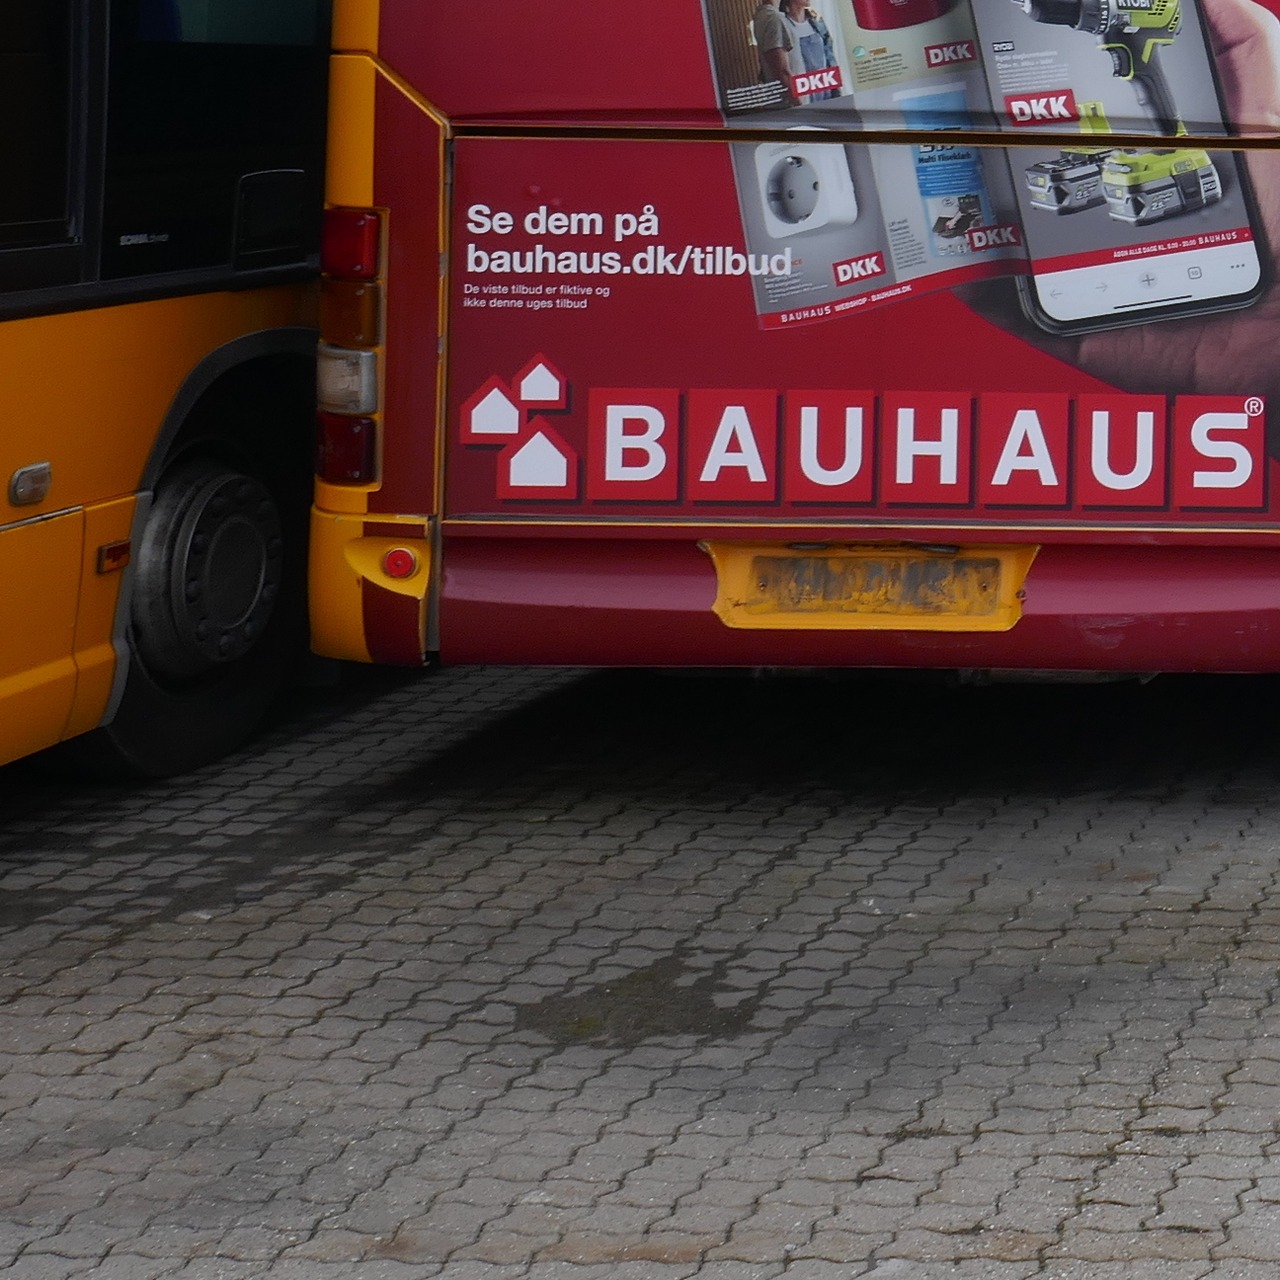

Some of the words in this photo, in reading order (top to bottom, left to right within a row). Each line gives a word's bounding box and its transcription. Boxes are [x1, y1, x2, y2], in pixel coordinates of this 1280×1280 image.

[928, 43, 972, 64] DKK
[795, 70, 839, 94] DKK
[1010, 95, 1072, 122] DKK
[467, 204, 514, 234] Se
[524, 206, 603, 235] dem
[614, 205, 659, 241] på
[972, 226, 1017, 248] DKK
[1198, 231, 1238, 245] BAUHAUS
[467, 244, 792, 276] bauhaus.dk/tilbud
[836, 255, 882, 282] DKK
[464, 284, 480, 294] De
[482, 284, 509, 294] viste
[511, 284, 543, 294] tilbud
[545, 286, 556, 294] er
[559, 284, 593, 295] fiktive
[595, 286, 610, 297] og
[463, 297, 486, 307] ikke
[488, 298, 524, 308] denne
[526, 300, 553, 310] uges
[555, 298, 588, 308] tilbud
[780, 305, 832, 323] BAUHAUS
